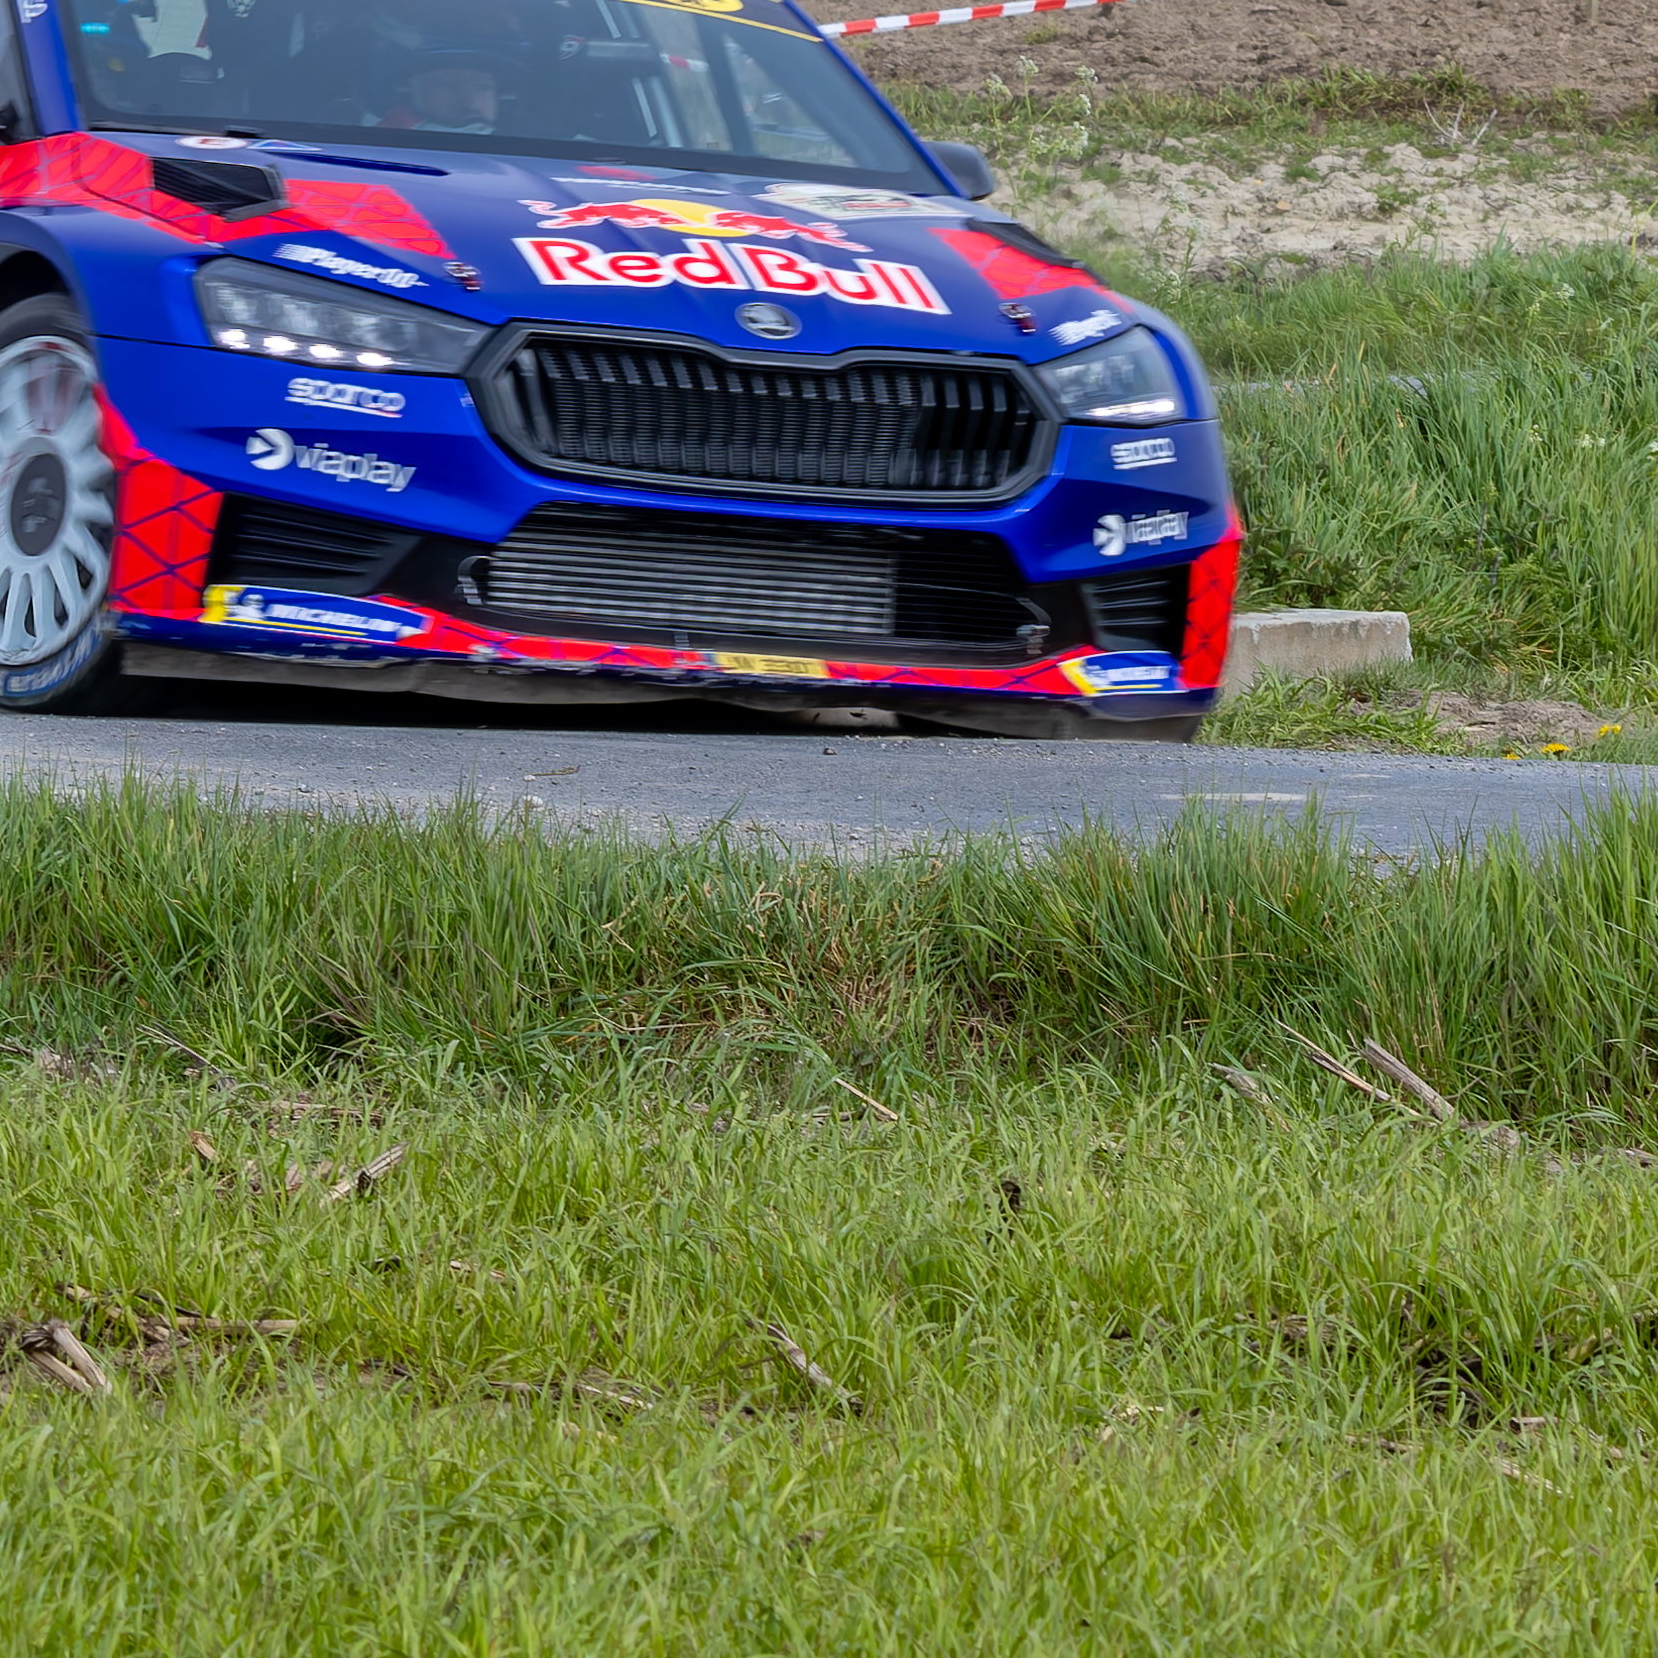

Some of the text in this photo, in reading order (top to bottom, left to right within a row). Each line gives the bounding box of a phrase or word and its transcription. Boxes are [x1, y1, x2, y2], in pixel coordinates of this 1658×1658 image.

[522, 239, 942, 312] Red Bull
[294, 443, 417, 492] viaplay
